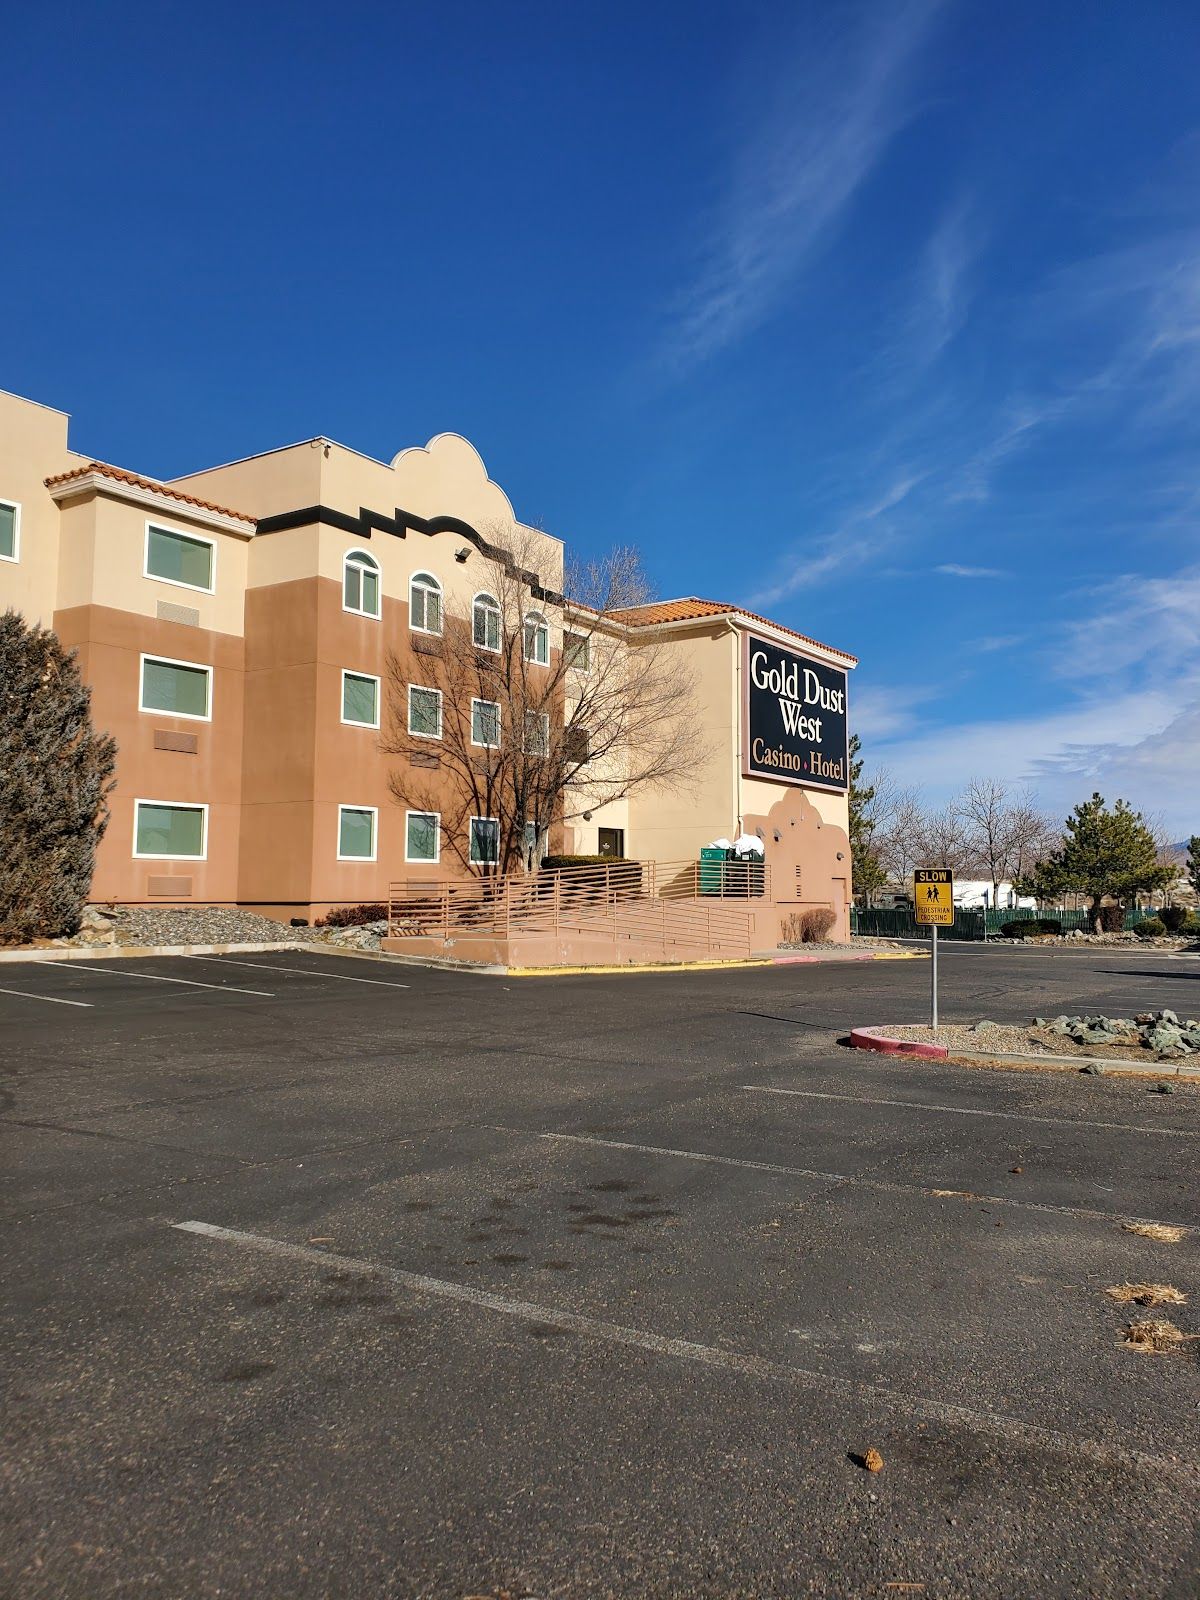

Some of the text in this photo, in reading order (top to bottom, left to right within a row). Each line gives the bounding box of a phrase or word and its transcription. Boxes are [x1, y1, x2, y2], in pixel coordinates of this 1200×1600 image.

[751, 651, 844, 714] Gold Dust
[778, 698, 822, 743] West
[752, 737, 844, 780] Casino Hotel
[919, 871, 947, 881] SLOW
[918, 906, 950, 914] PEDESTRIAN
